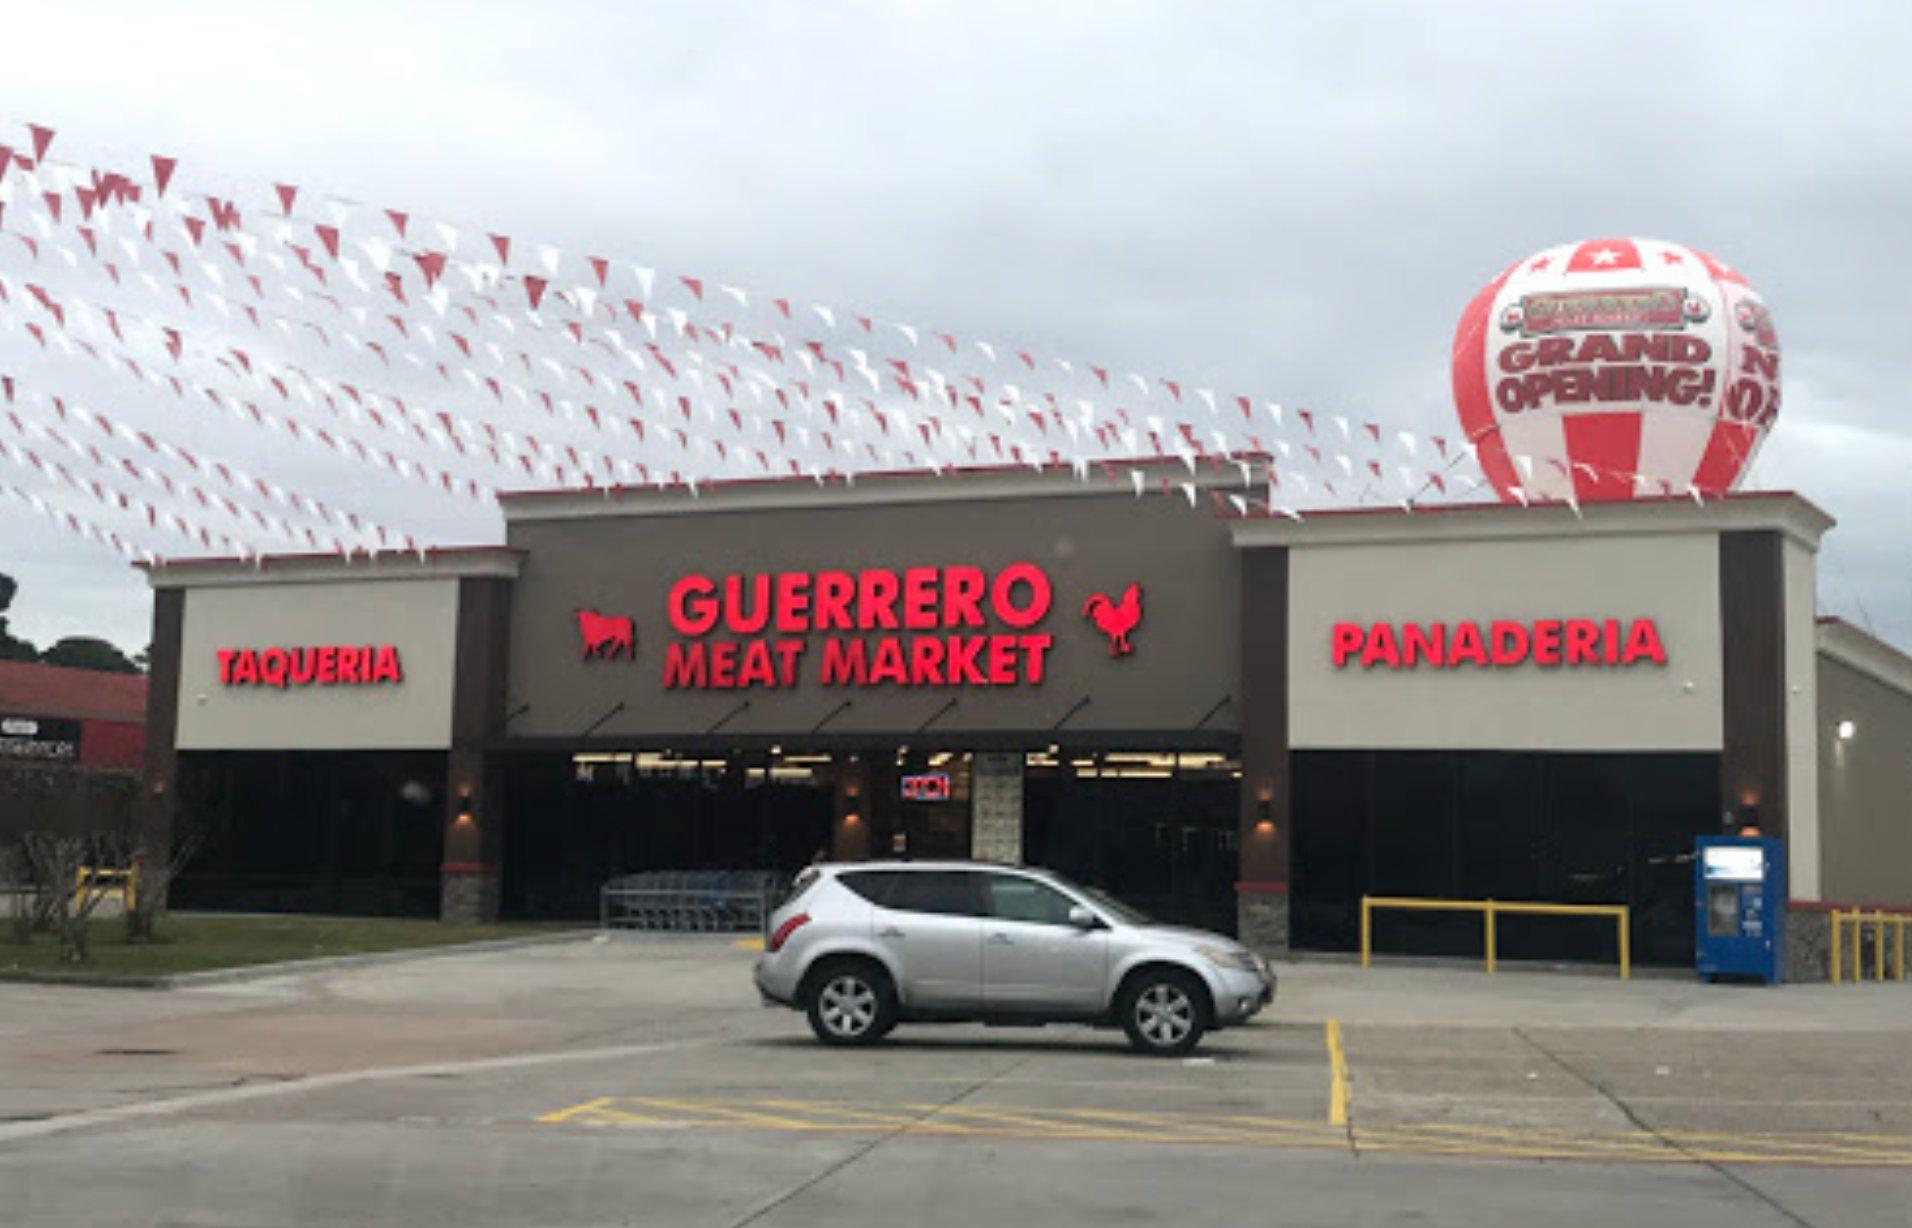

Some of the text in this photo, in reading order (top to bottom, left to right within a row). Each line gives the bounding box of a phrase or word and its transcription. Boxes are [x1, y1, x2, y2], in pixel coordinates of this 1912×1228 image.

[1497, 333, 1711, 373] GRAND
[1496, 365, 1716, 413] OPENING!
[667, 561, 1053, 636] GUERRERO
[215, 645, 402, 687] TAQUERIA
[662, 633, 1053, 688] MEAT MARKET
[1331, 618, 1667, 668] PANADERIA
